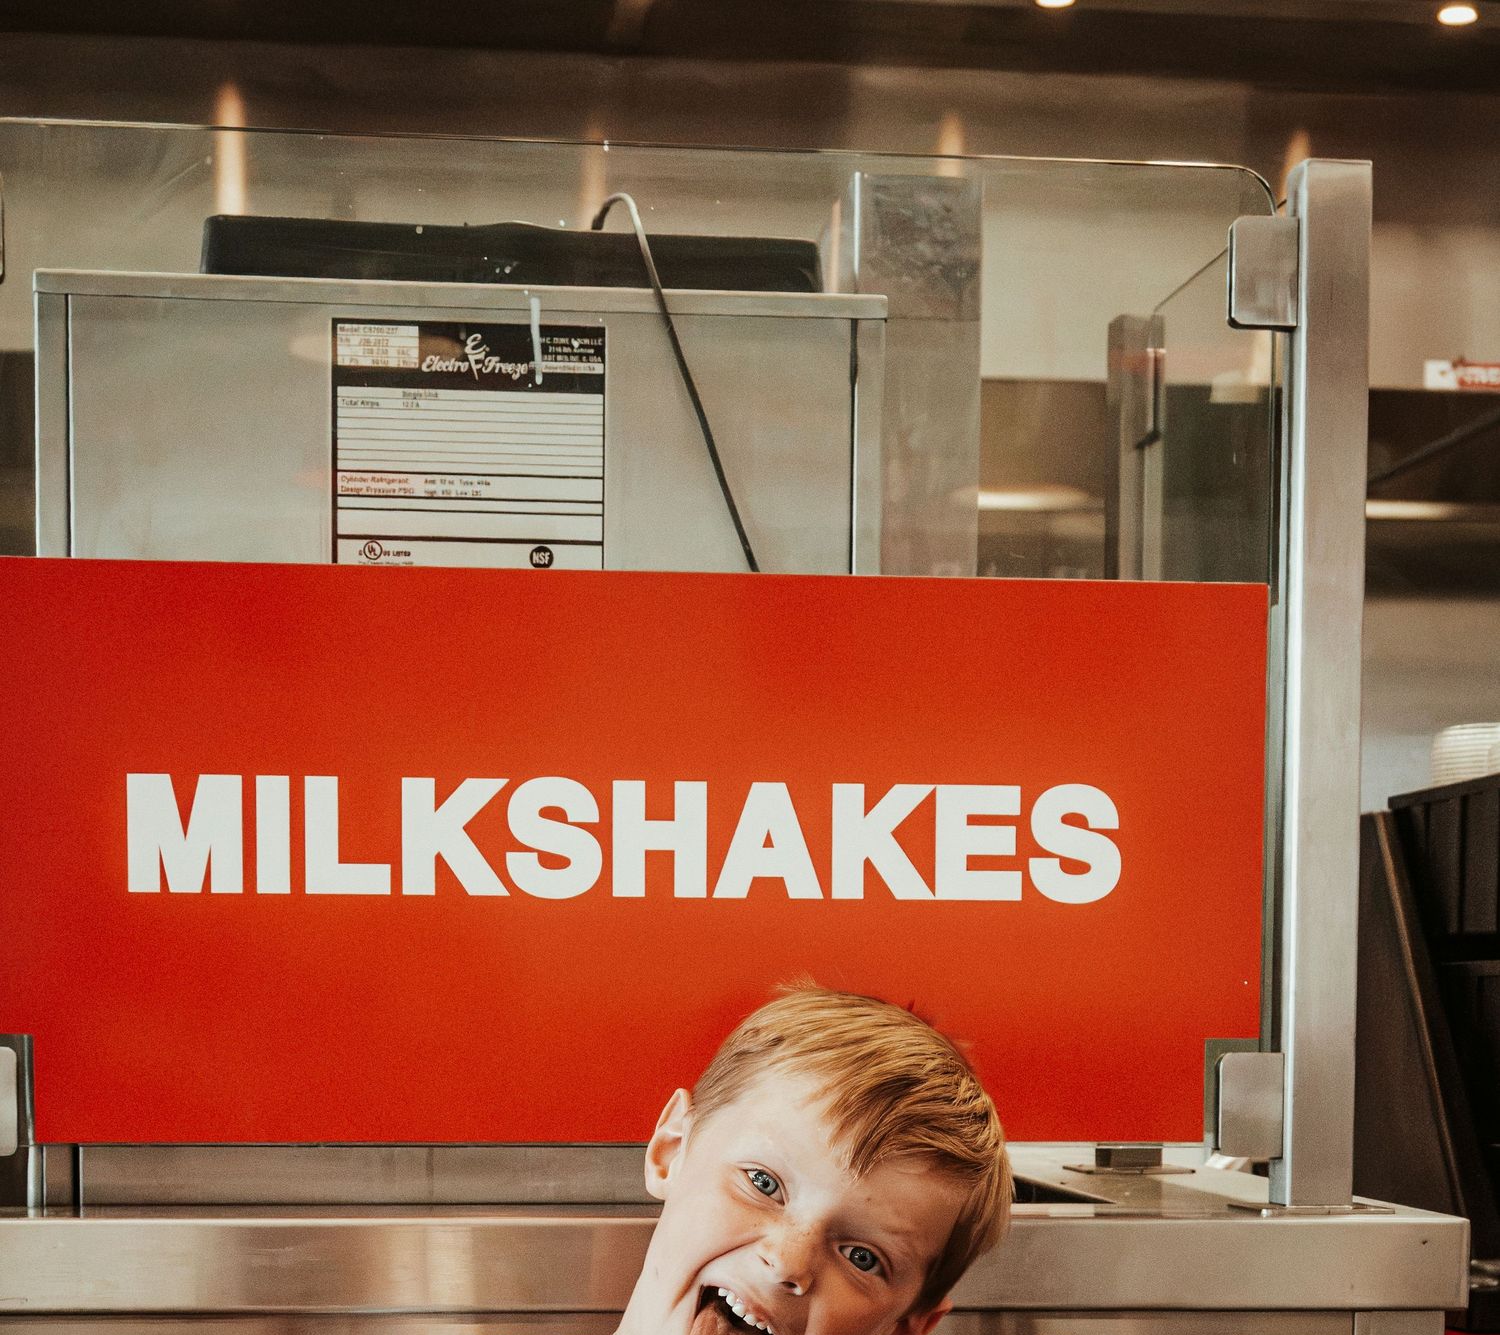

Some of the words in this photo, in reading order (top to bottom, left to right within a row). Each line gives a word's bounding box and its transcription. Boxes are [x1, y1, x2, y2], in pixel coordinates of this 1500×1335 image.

[421, 355, 470, 373] Electro
[482, 356, 529, 381] Freeze
[532, 551, 551, 565] NSF
[127, 774, 1121, 904] MILKSHAKES
